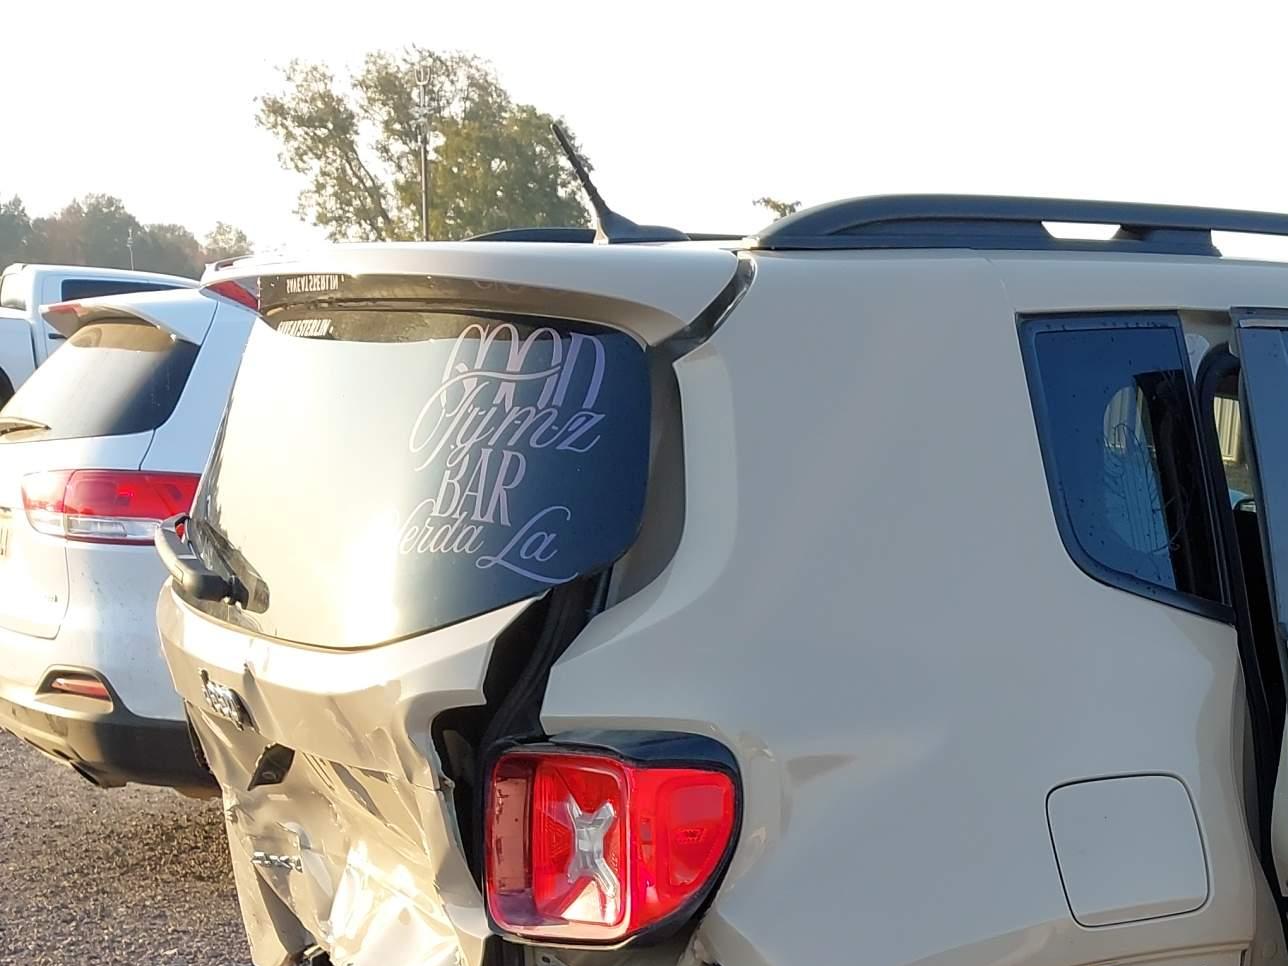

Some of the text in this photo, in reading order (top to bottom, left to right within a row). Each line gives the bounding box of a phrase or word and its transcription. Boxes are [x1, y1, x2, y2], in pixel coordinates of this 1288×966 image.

[439, 322, 606, 412] GOOD
[432, 448, 526, 527] BAR
[475, 505, 579, 585] La
